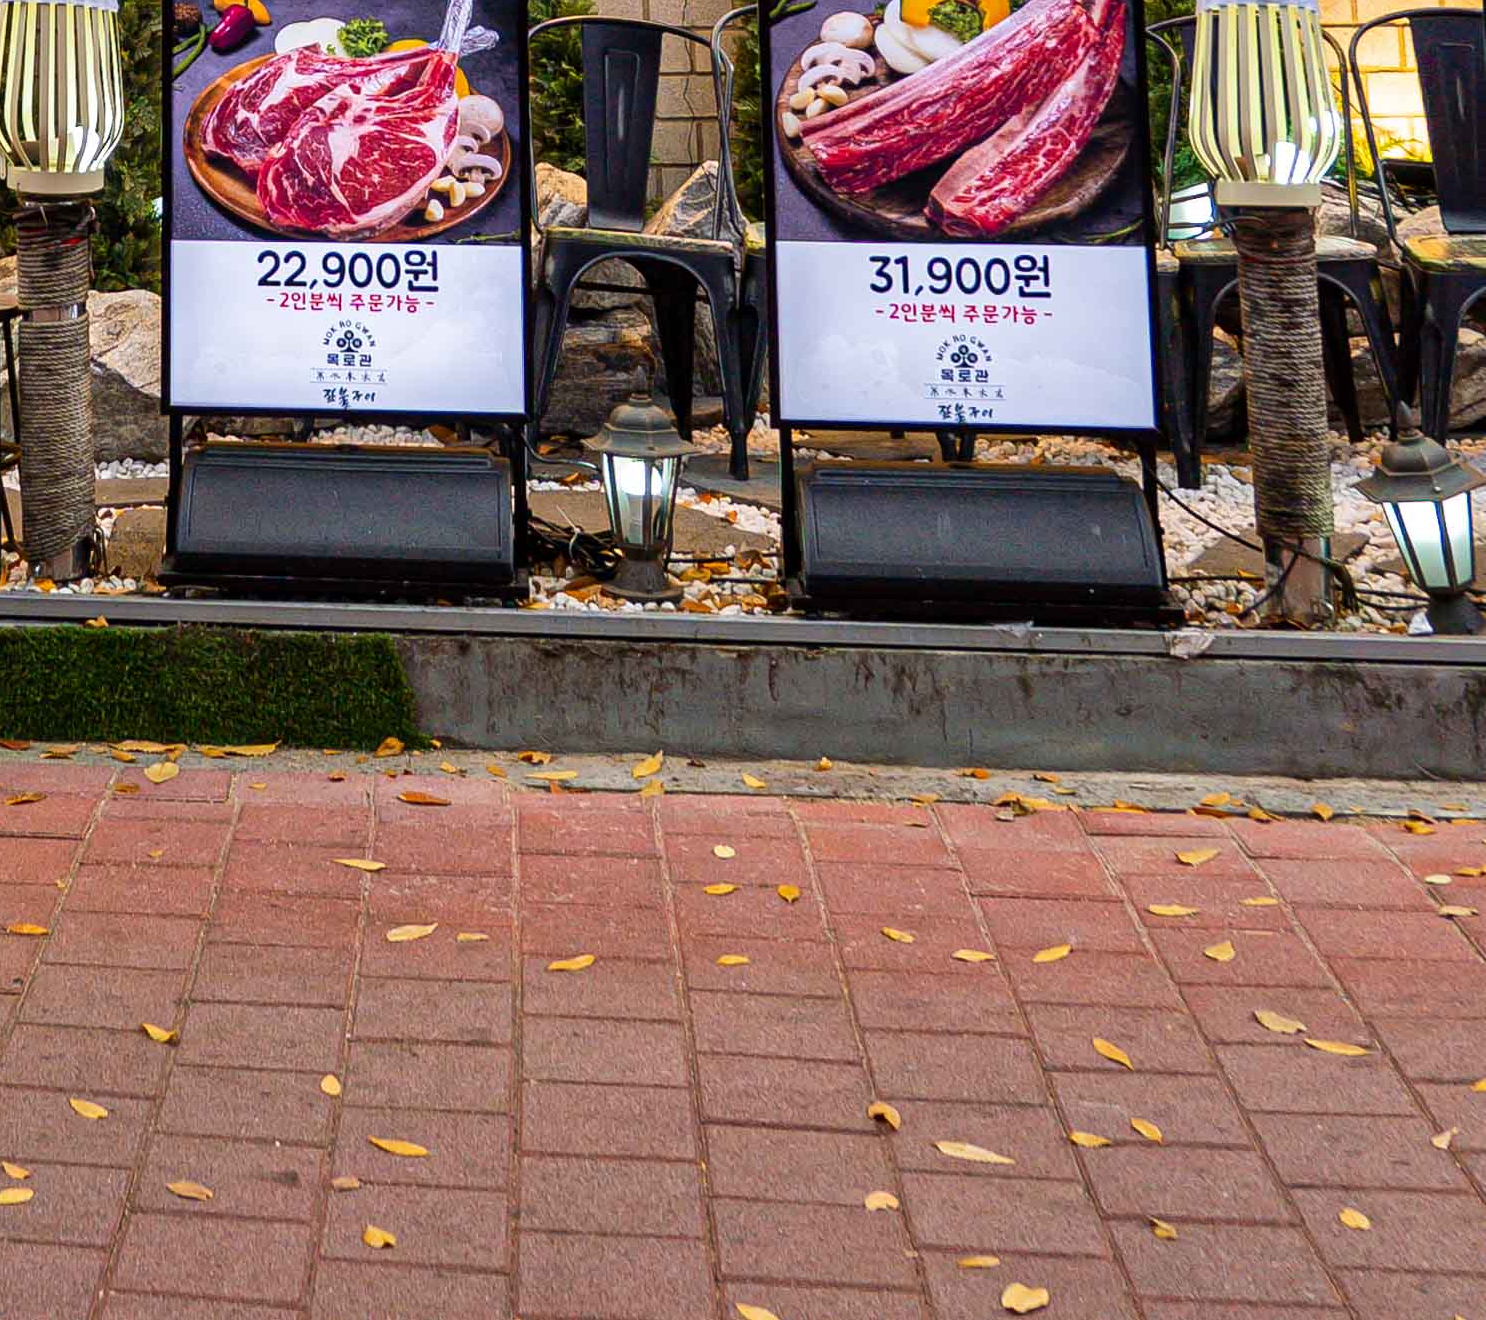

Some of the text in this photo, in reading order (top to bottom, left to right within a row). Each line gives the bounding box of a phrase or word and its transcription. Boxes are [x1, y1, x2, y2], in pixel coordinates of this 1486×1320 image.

[256, 249, 439, 293] 22,900원
[868, 253, 1053, 299] 31,900원
[279, 292, 421, 313] 2인분씩 주문가능
